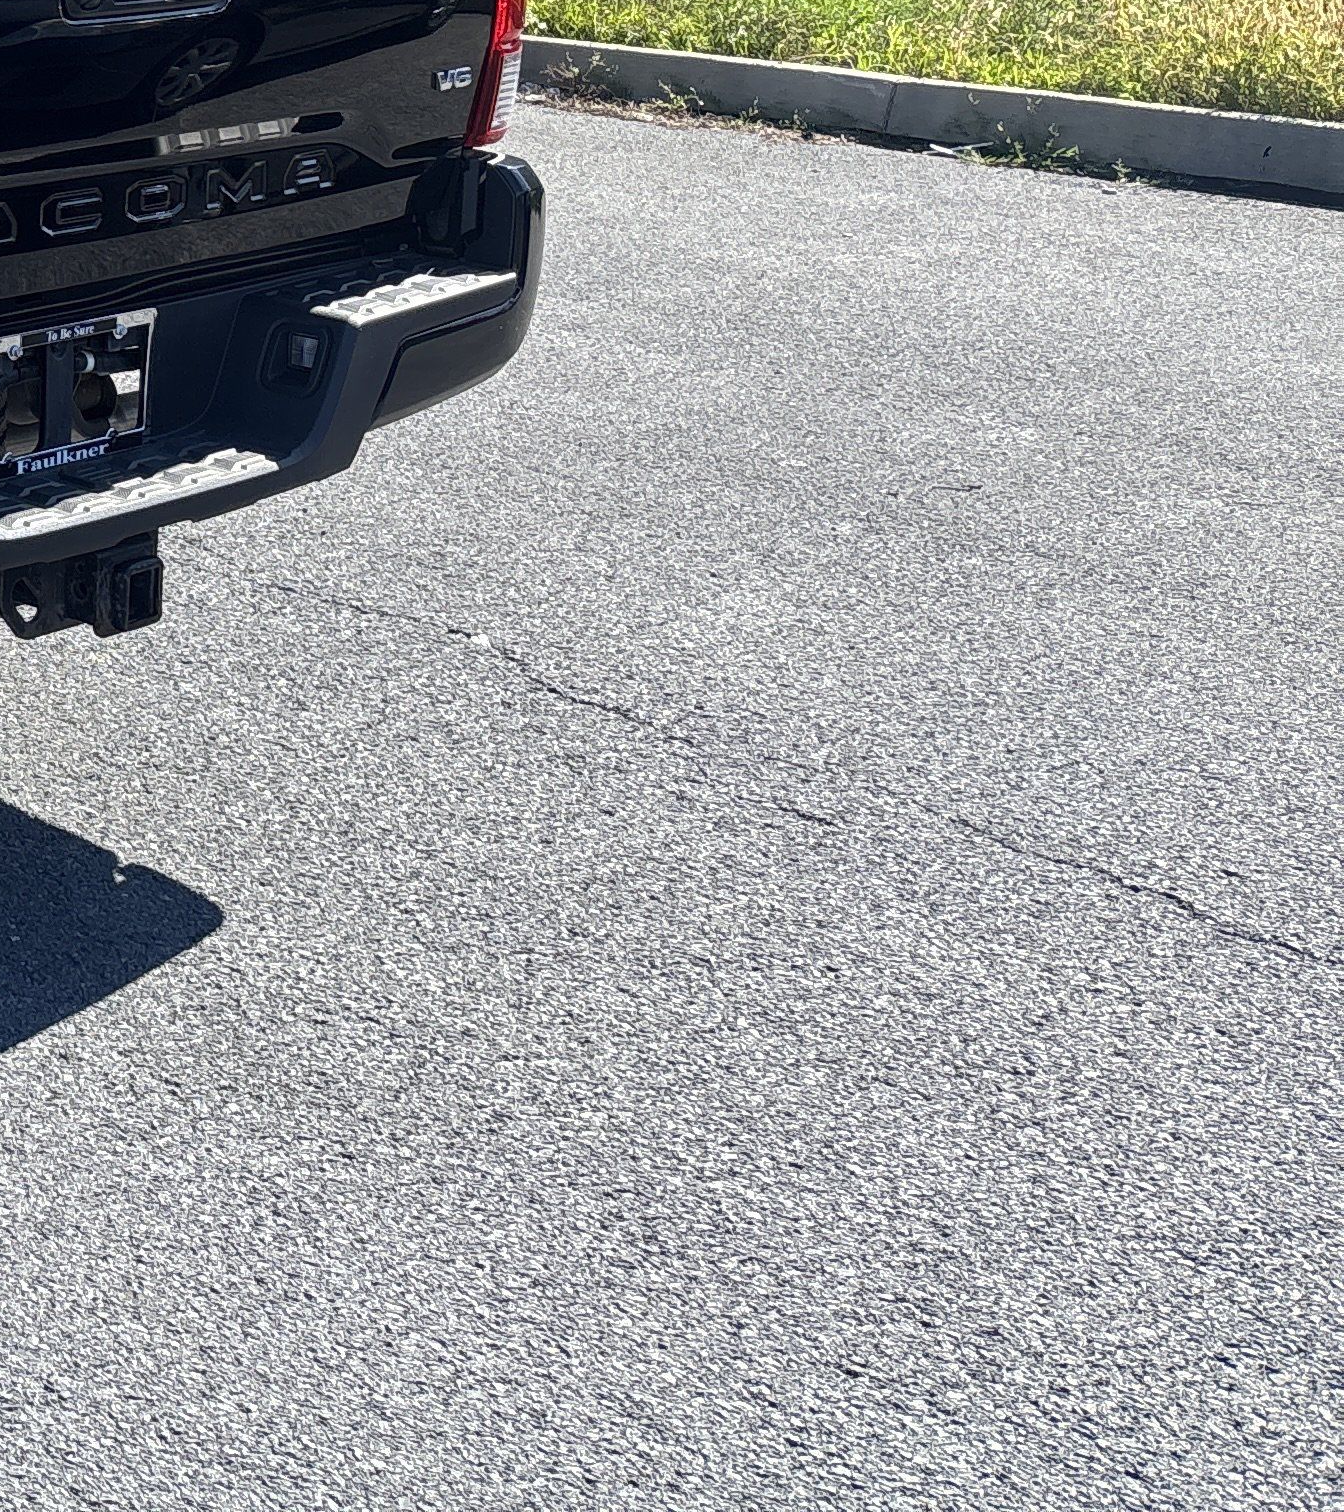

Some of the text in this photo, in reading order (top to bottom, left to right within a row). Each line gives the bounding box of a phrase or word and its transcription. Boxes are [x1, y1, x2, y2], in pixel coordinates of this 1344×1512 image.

[433, 65, 473, 92] V6
[45, 324, 95, 343] To Be Sure
[15, 441, 110, 476] Faulkner
